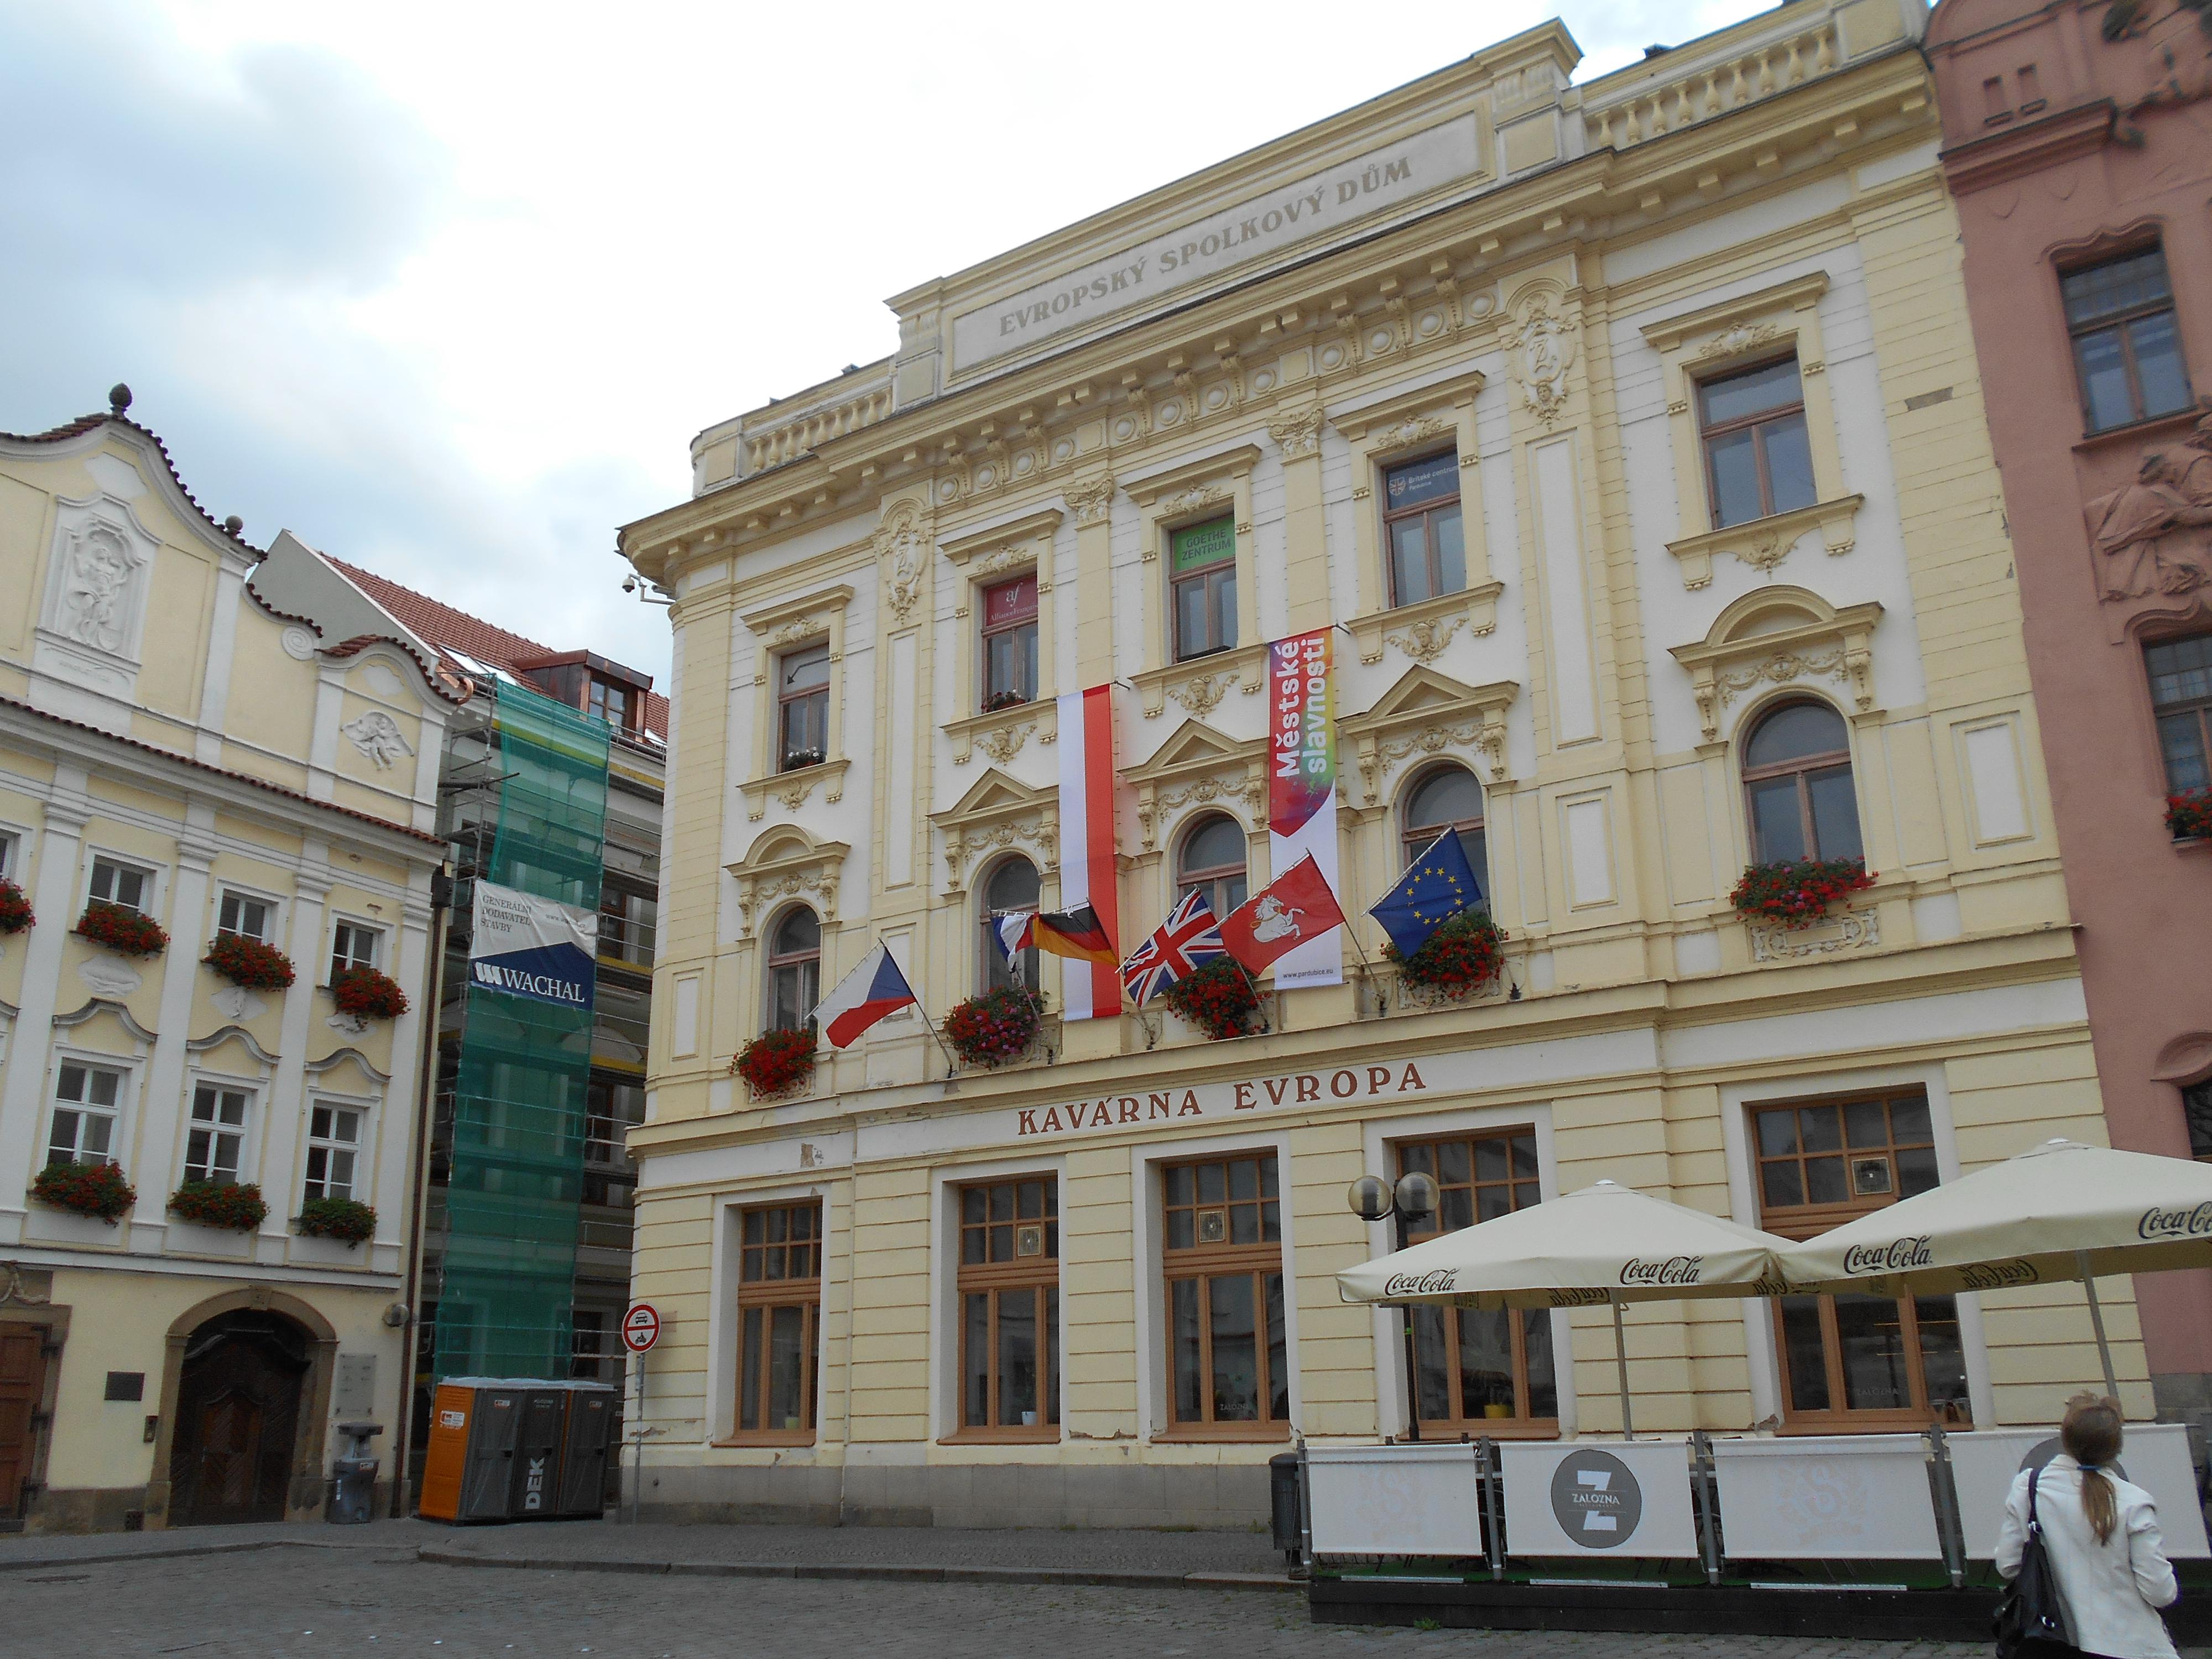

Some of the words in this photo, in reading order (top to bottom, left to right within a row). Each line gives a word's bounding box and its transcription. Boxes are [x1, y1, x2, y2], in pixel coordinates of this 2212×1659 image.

[999, 256, 1147, 336] EVROPSKÝ
[1159, 185, 1325, 274] SPOLKOVÝ
[1336, 156, 1412, 205] DŮM
[1182, 538, 1231, 561] ZENTRUM
[1186, 529, 1226, 547] GOETHE
[1275, 641, 1300, 777] Městské
[1301, 637, 1327, 773] slavnosti
[480, 919, 513, 932] STAVBY
[482, 906, 530, 926] DODAVATEL
[502, 968, 585, 1003] WACHAL
[1283, 968, 1333, 978] www.pardubice.eu
[1018, 1089, 1202, 1135] KAVÁRNA
[1234, 1062, 1427, 1110] EVROPA
[1620, 1256, 1704, 1285] Coca-Cola
[1844, 1235, 1933, 1274] Coca-Cola
[1384, 1268, 1460, 1296] Coca-Cola
[525, 1457, 545, 1509] DEK
